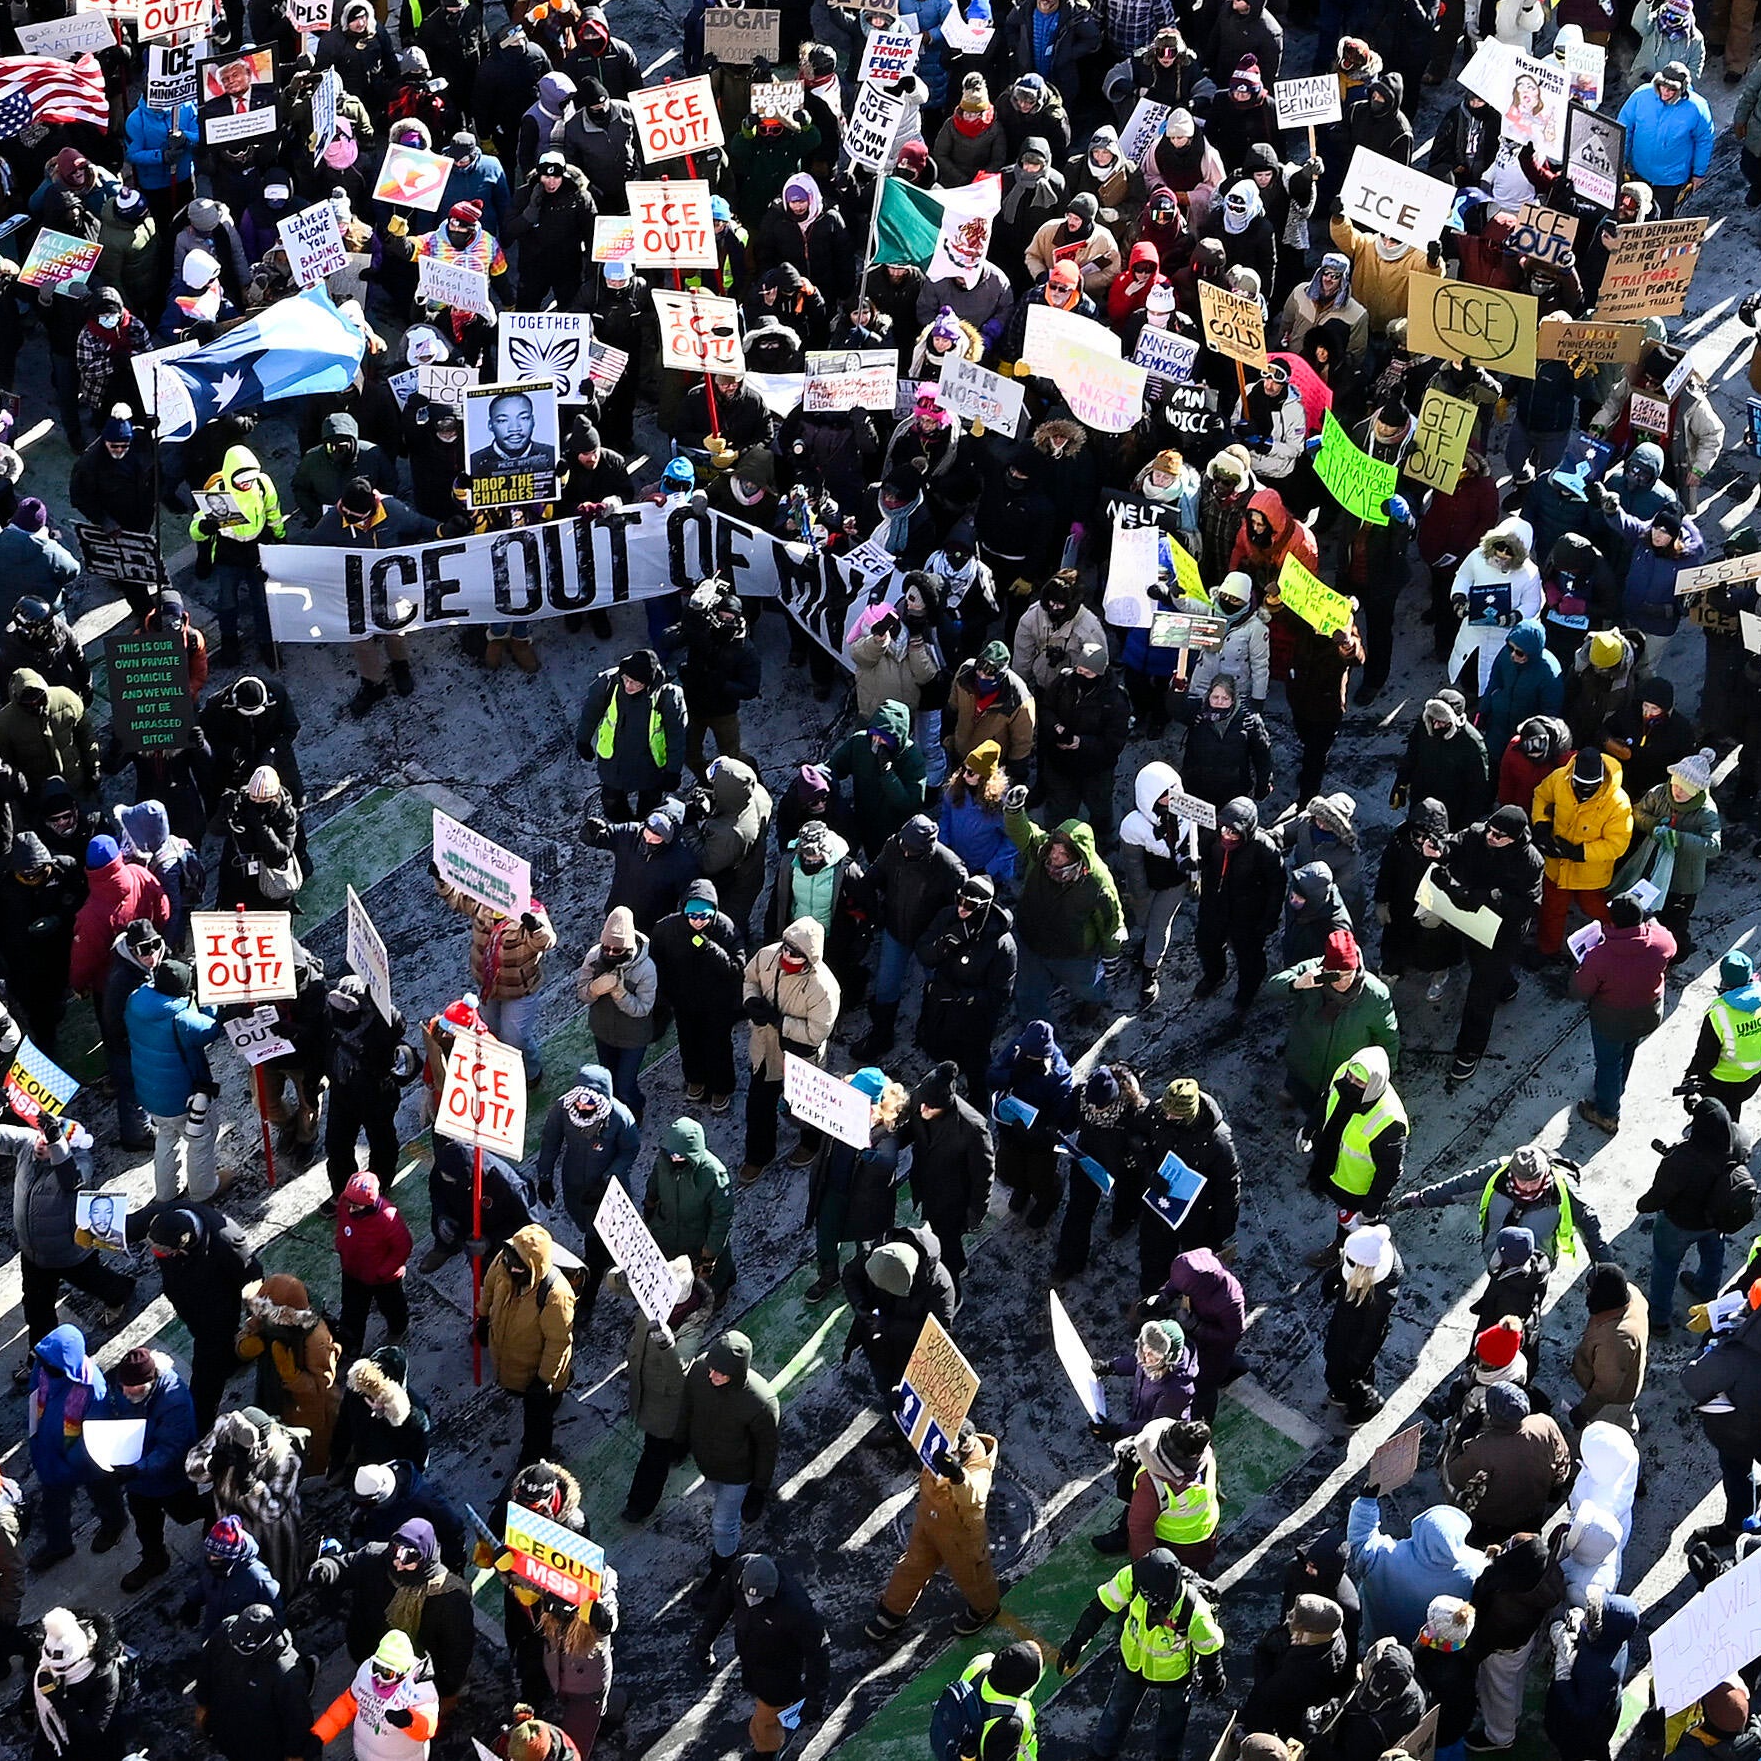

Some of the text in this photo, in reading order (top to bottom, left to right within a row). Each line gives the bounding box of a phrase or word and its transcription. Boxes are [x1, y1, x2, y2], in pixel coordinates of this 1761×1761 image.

[1277, 80, 1331, 98] HUMAN
[644, 95, 698, 124] ICE
[1279, 93, 1335, 115] BEINGS!
[647, 118, 708, 151] OUT!
[641, 203, 696, 226] ICE
[1350, 186, 1420, 235] ICE
[644, 230, 705, 252] OUT!
[510, 316, 579, 329] TOGETHER
[431, 369, 468, 387] NO
[1172, 388, 1205, 408] MN
[1423, 398, 1471, 429] GET
[1409, 447, 1452, 484] OUT
[473, 473, 534, 493] DROP THE
[473, 487, 533, 505] CHARGES
[345, 513, 754, 635] ICE OUT OF
[127, 672, 172, 683] DOMICILE
[131, 719, 181, 730] HARASSED
[142, 734, 173, 744] BITCH!
[207, 935, 276, 958] ICE
[208, 962, 282, 986] OUT!
[449, 1054, 509, 1100] ICE
[449, 1085, 514, 1129] OUT!
